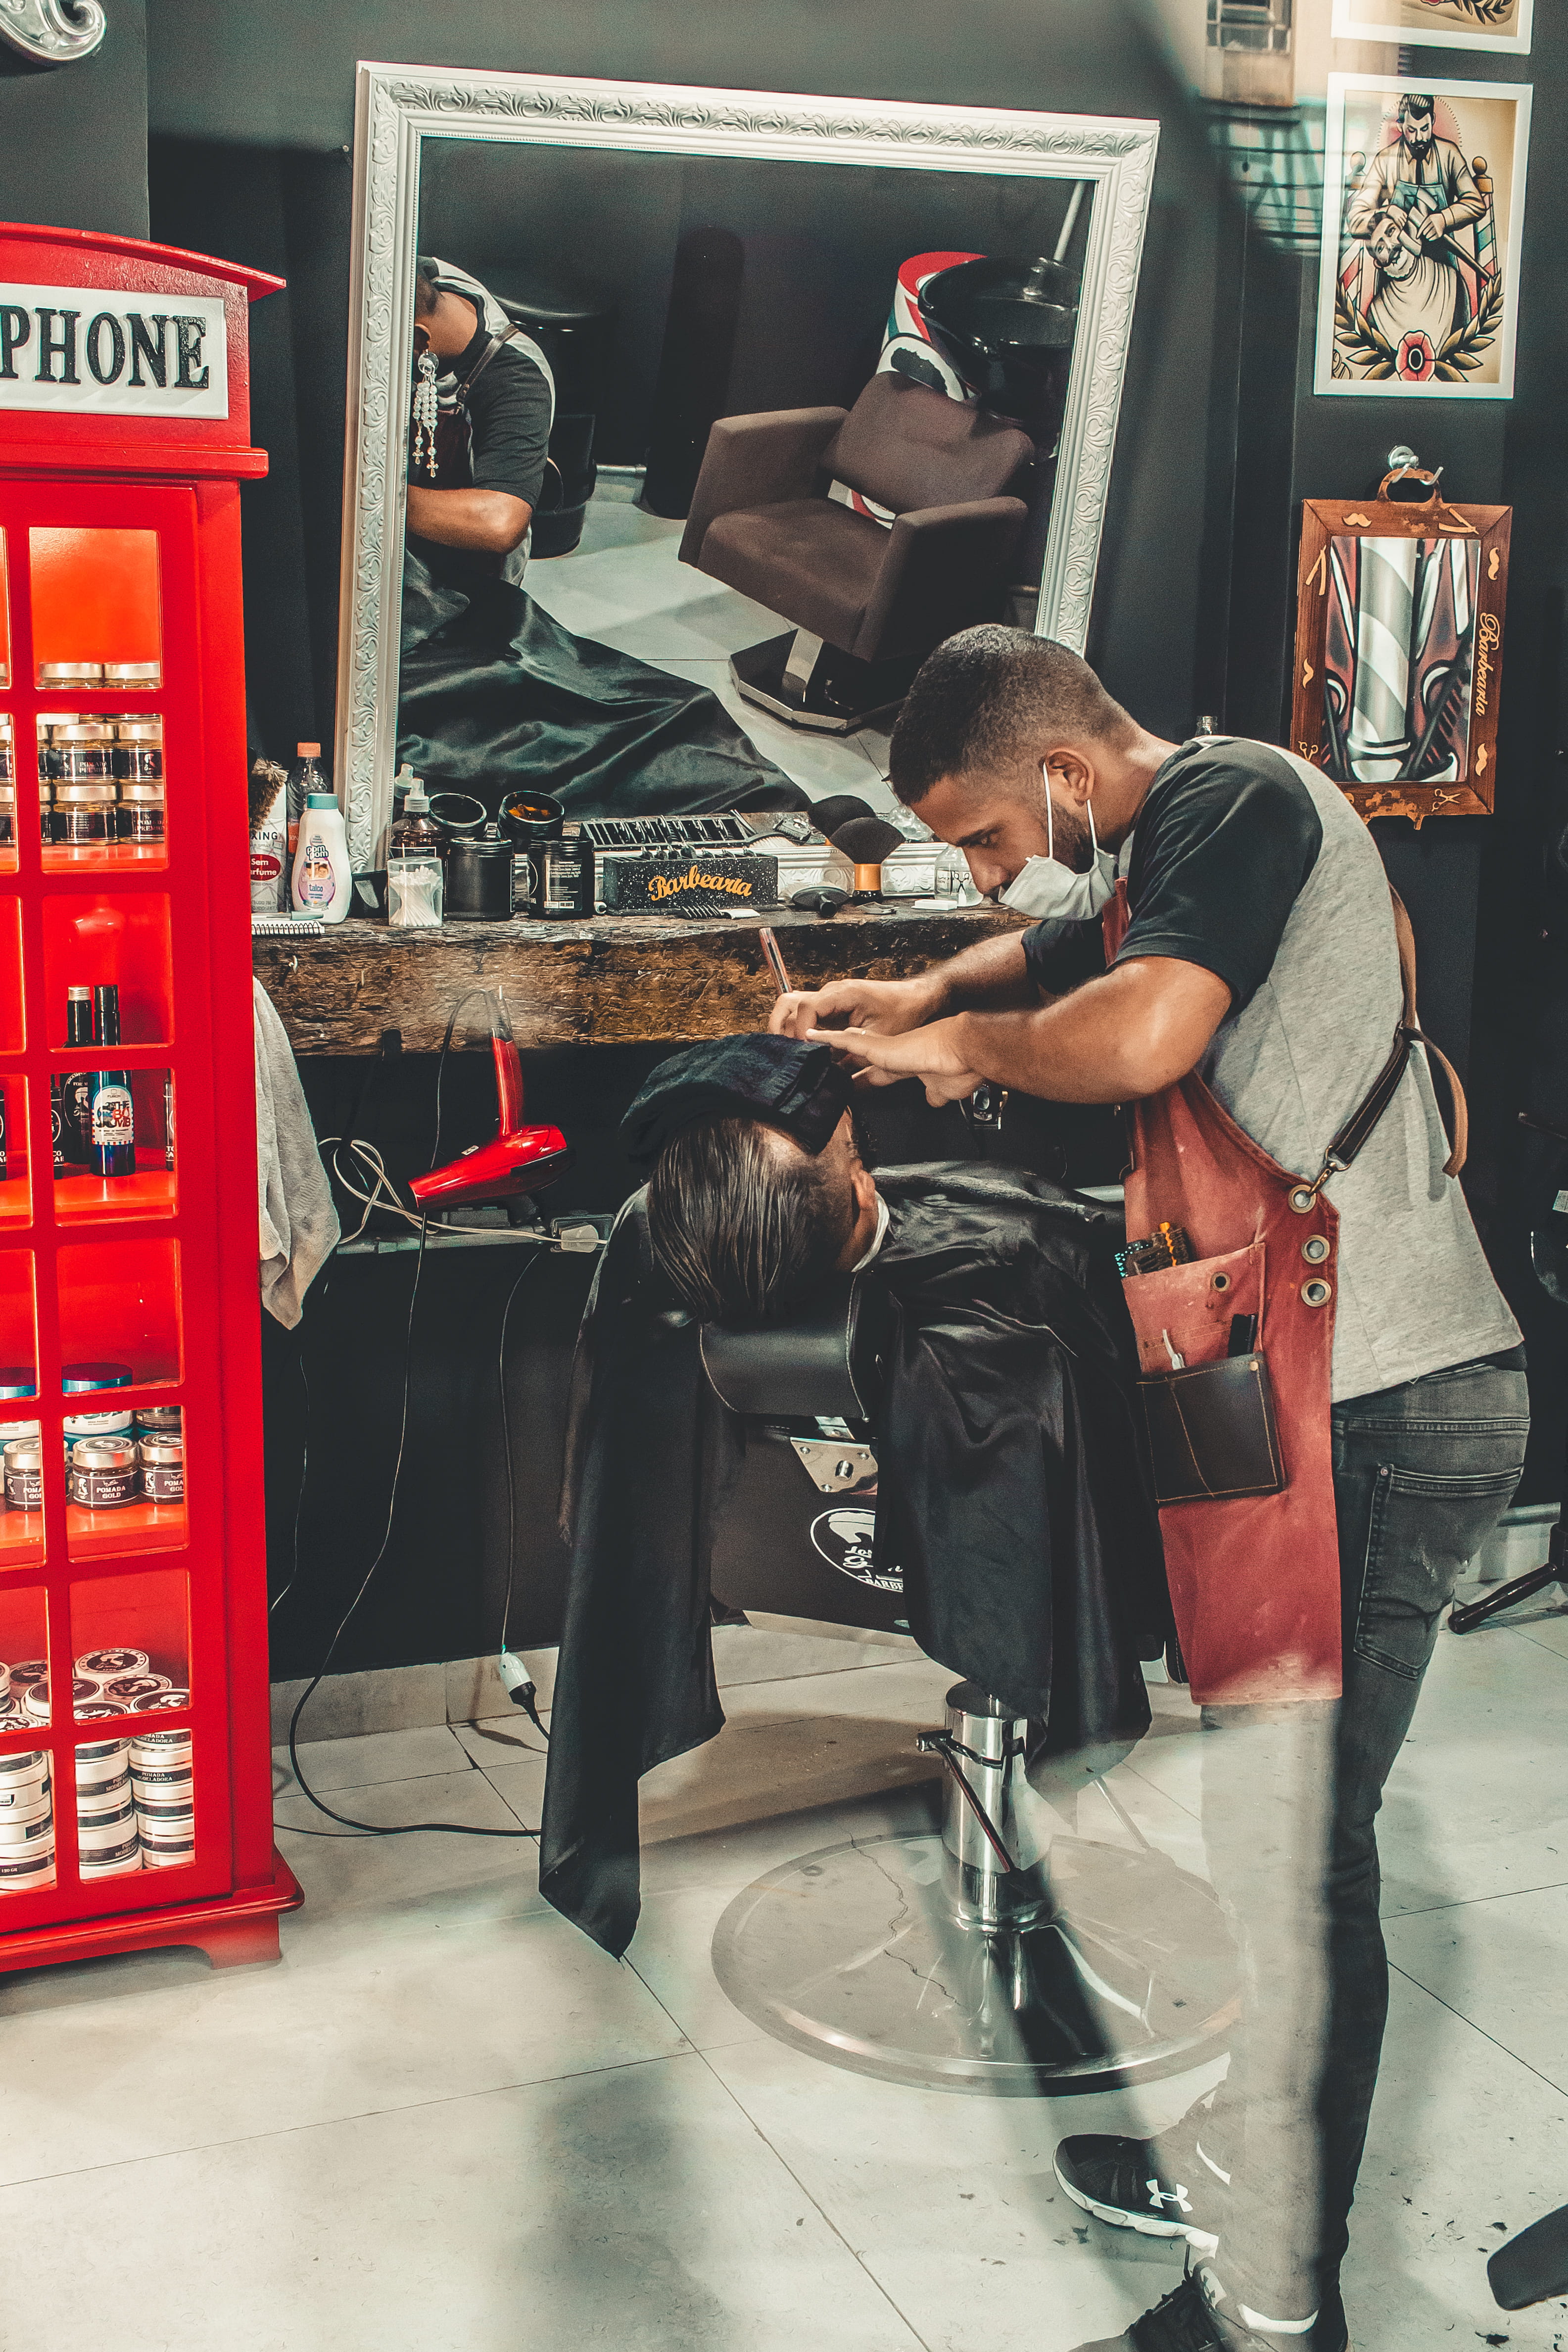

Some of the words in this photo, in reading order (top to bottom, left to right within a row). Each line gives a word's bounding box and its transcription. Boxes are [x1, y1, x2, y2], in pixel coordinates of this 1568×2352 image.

[0, 304, 209, 389] PHONE
[1475, 612, 1500, 716] Barbearia
[307, 845, 326, 855] pom
[648, 865, 752, 901] Barbearia
